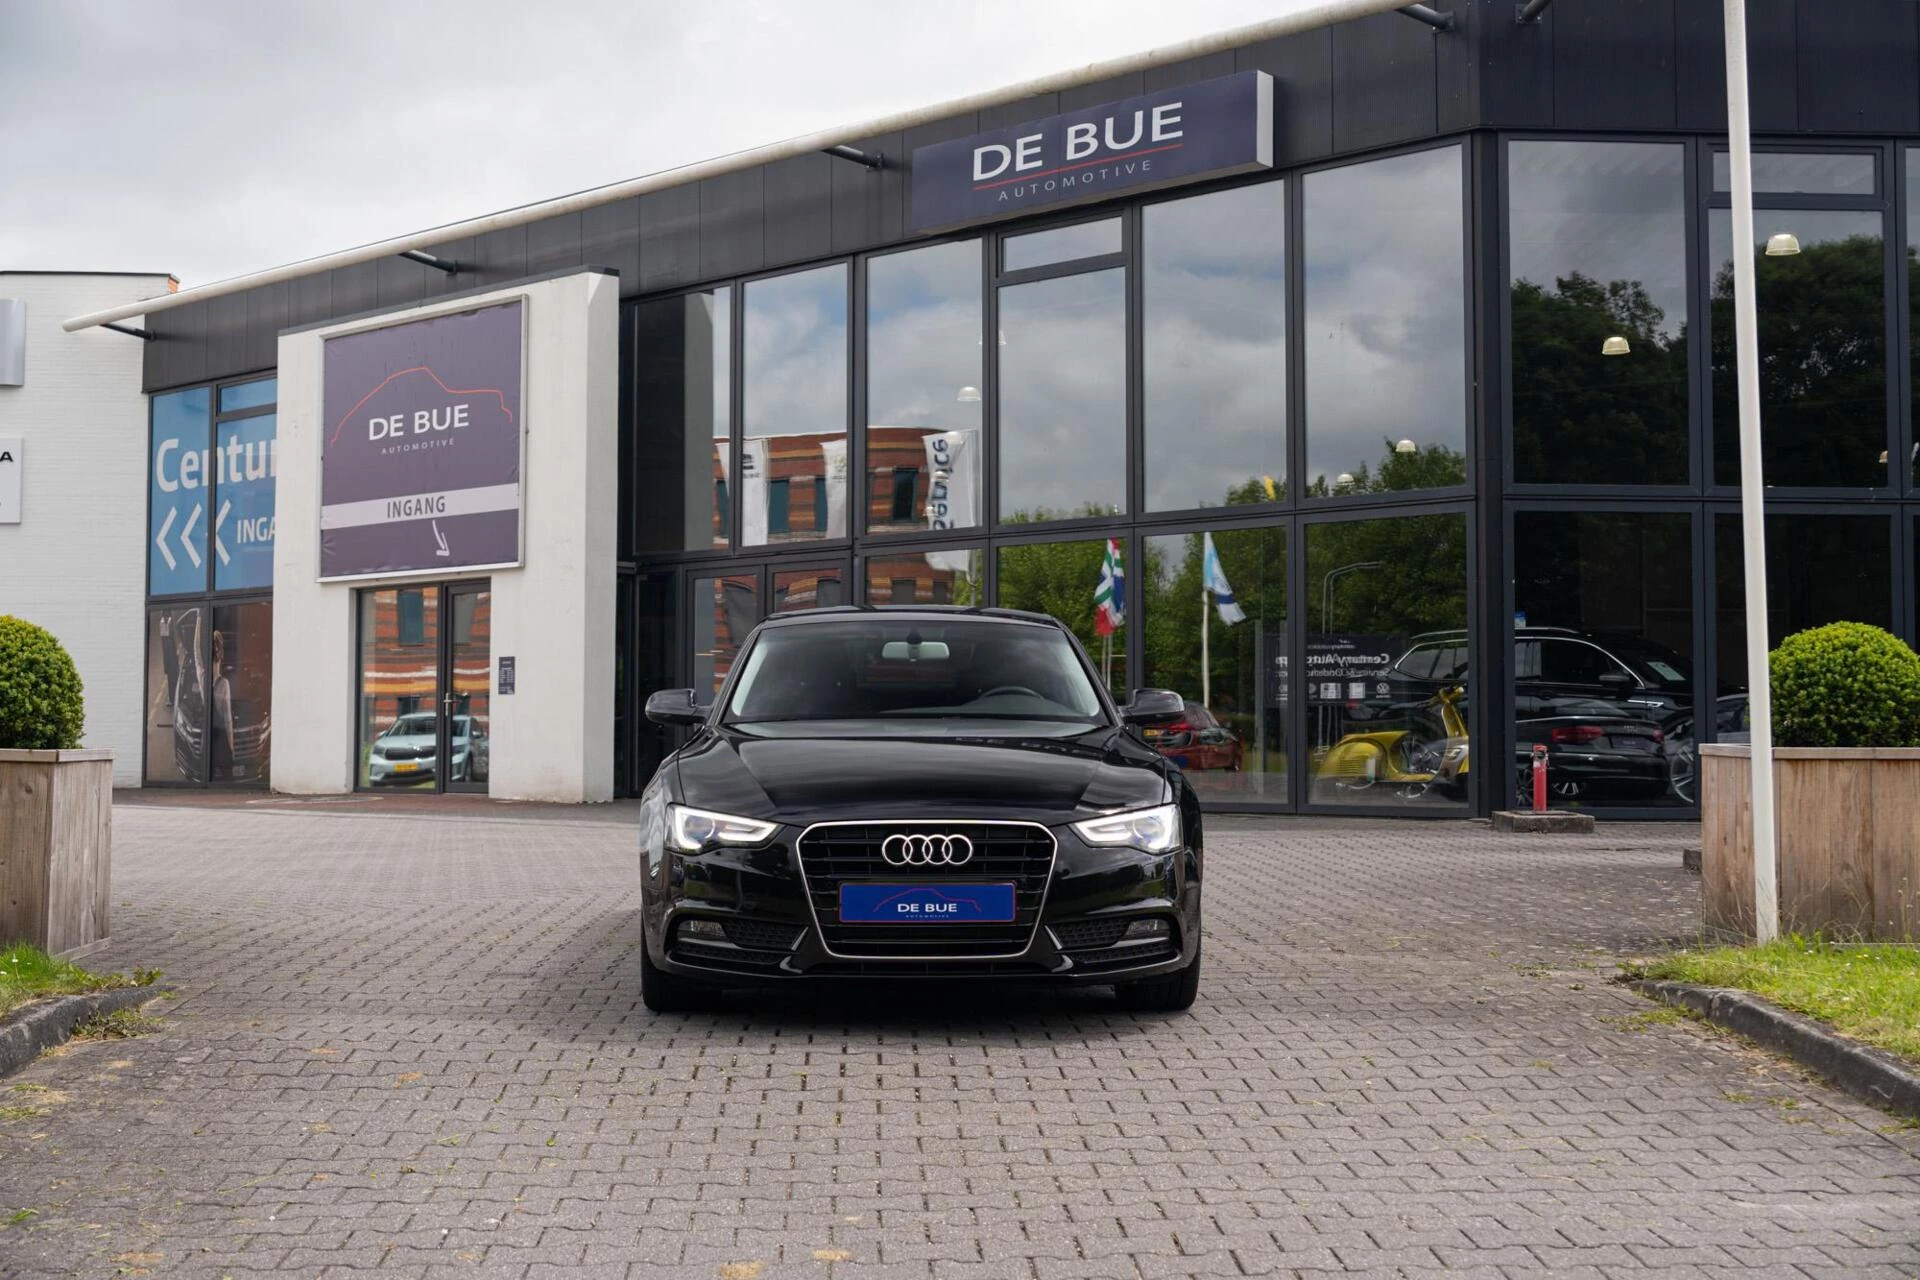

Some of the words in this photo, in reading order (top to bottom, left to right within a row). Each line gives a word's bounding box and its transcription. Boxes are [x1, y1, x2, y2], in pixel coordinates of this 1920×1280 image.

[972, 133, 1043, 182] DE
[1066, 101, 1184, 161] BUE
[998, 159, 1152, 202] AUTOMOTIVE
[369, 414, 404, 441] DE
[414, 404, 469, 434] BUE
[381, 438, 455, 455] AUTOMOTIVE
[387, 495, 446, 519] INGANG
[897, 903, 920, 913] DE
[925, 903, 958, 913] BUE
